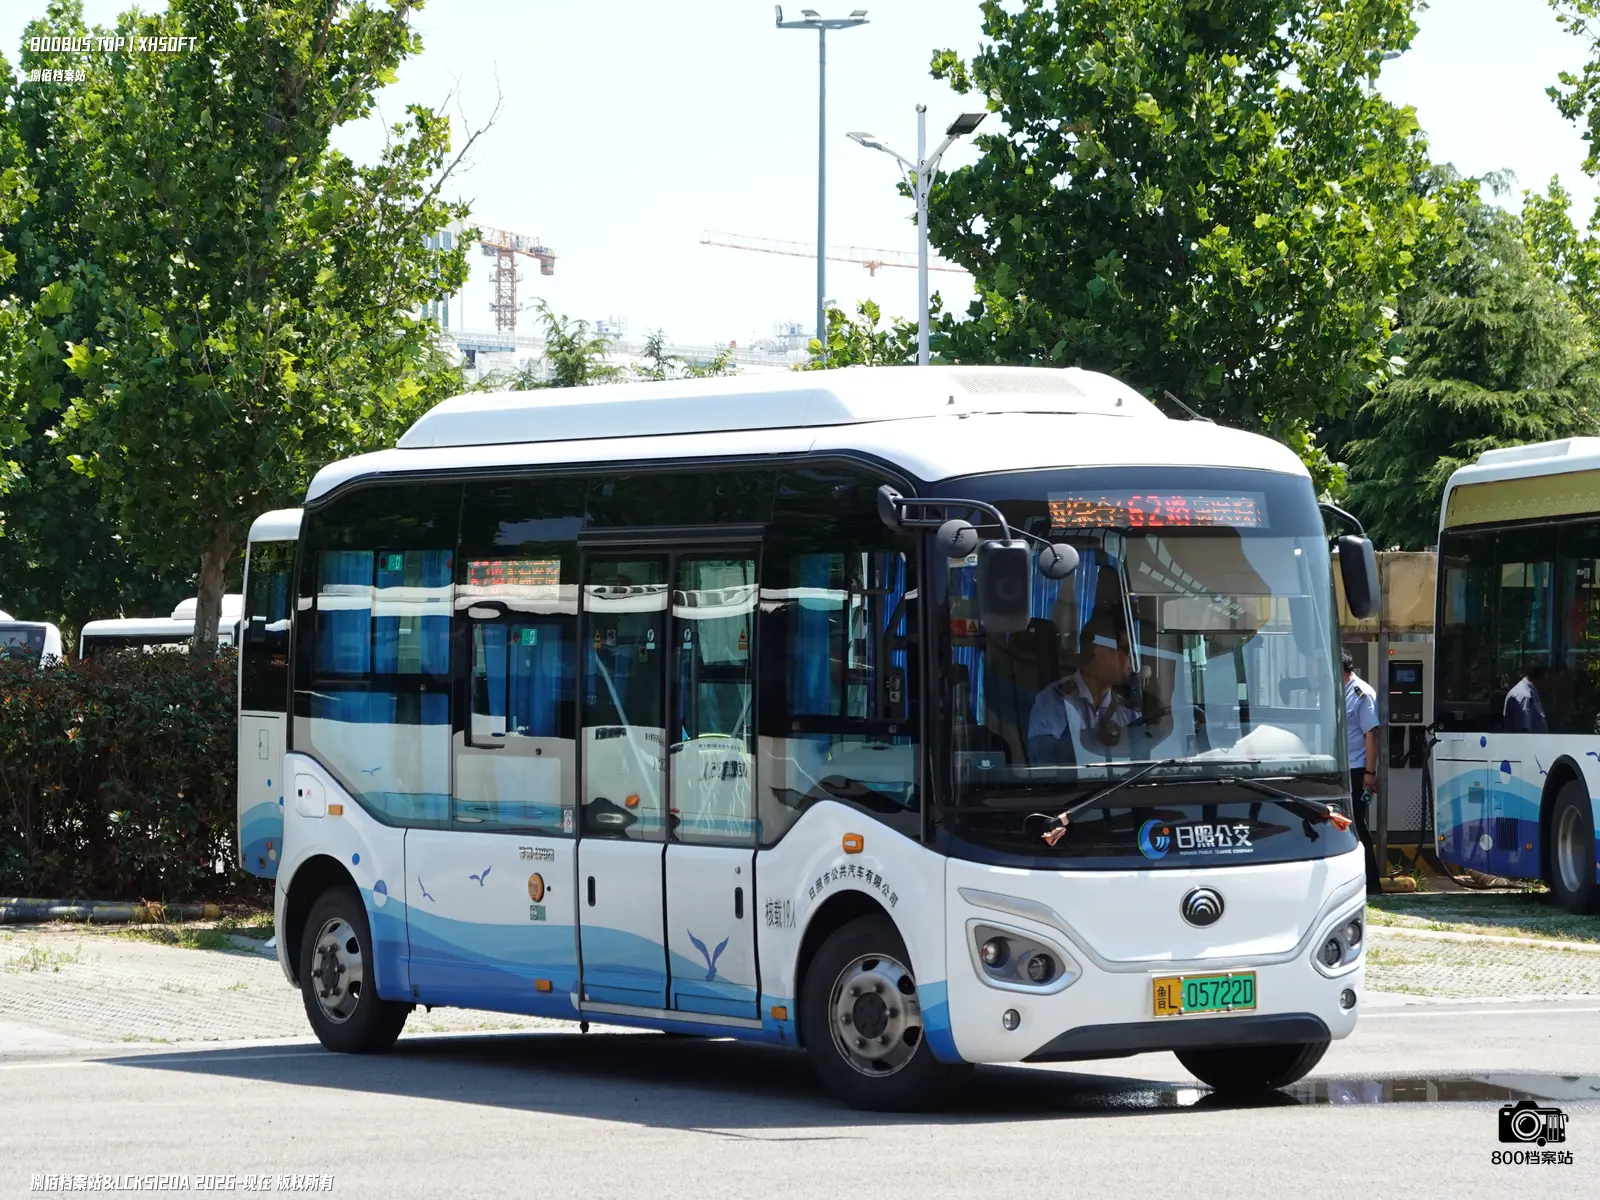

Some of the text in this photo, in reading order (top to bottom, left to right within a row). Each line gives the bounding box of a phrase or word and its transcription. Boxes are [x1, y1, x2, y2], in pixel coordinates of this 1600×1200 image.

[1176, 824, 1252, 849] 日照公交
[808, 864, 899, 908] 日照市公共汽车有限公司
[765, 899, 797, 929] 核载19人
